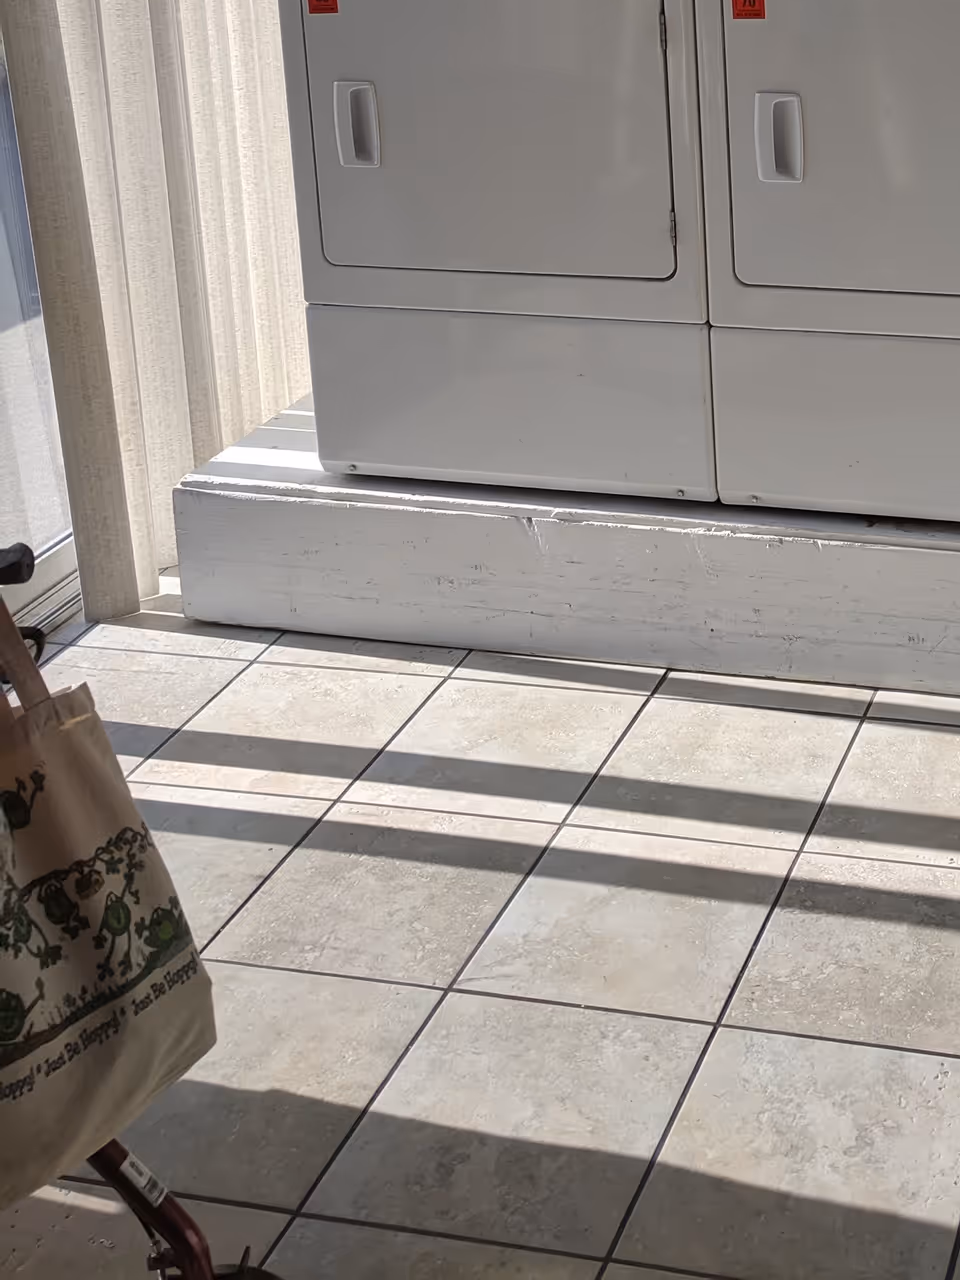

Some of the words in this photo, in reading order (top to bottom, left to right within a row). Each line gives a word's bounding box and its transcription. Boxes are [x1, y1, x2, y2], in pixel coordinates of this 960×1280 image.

[43, 1053, 66, 1078] Just
[64, 1041, 81, 1062] Be
[79, 1009, 120, 1049] Hoppy!
[131, 994, 153, 1016] Just
[150, 980, 166, 999] Be
[163, 951, 200, 990] Hoppy!
